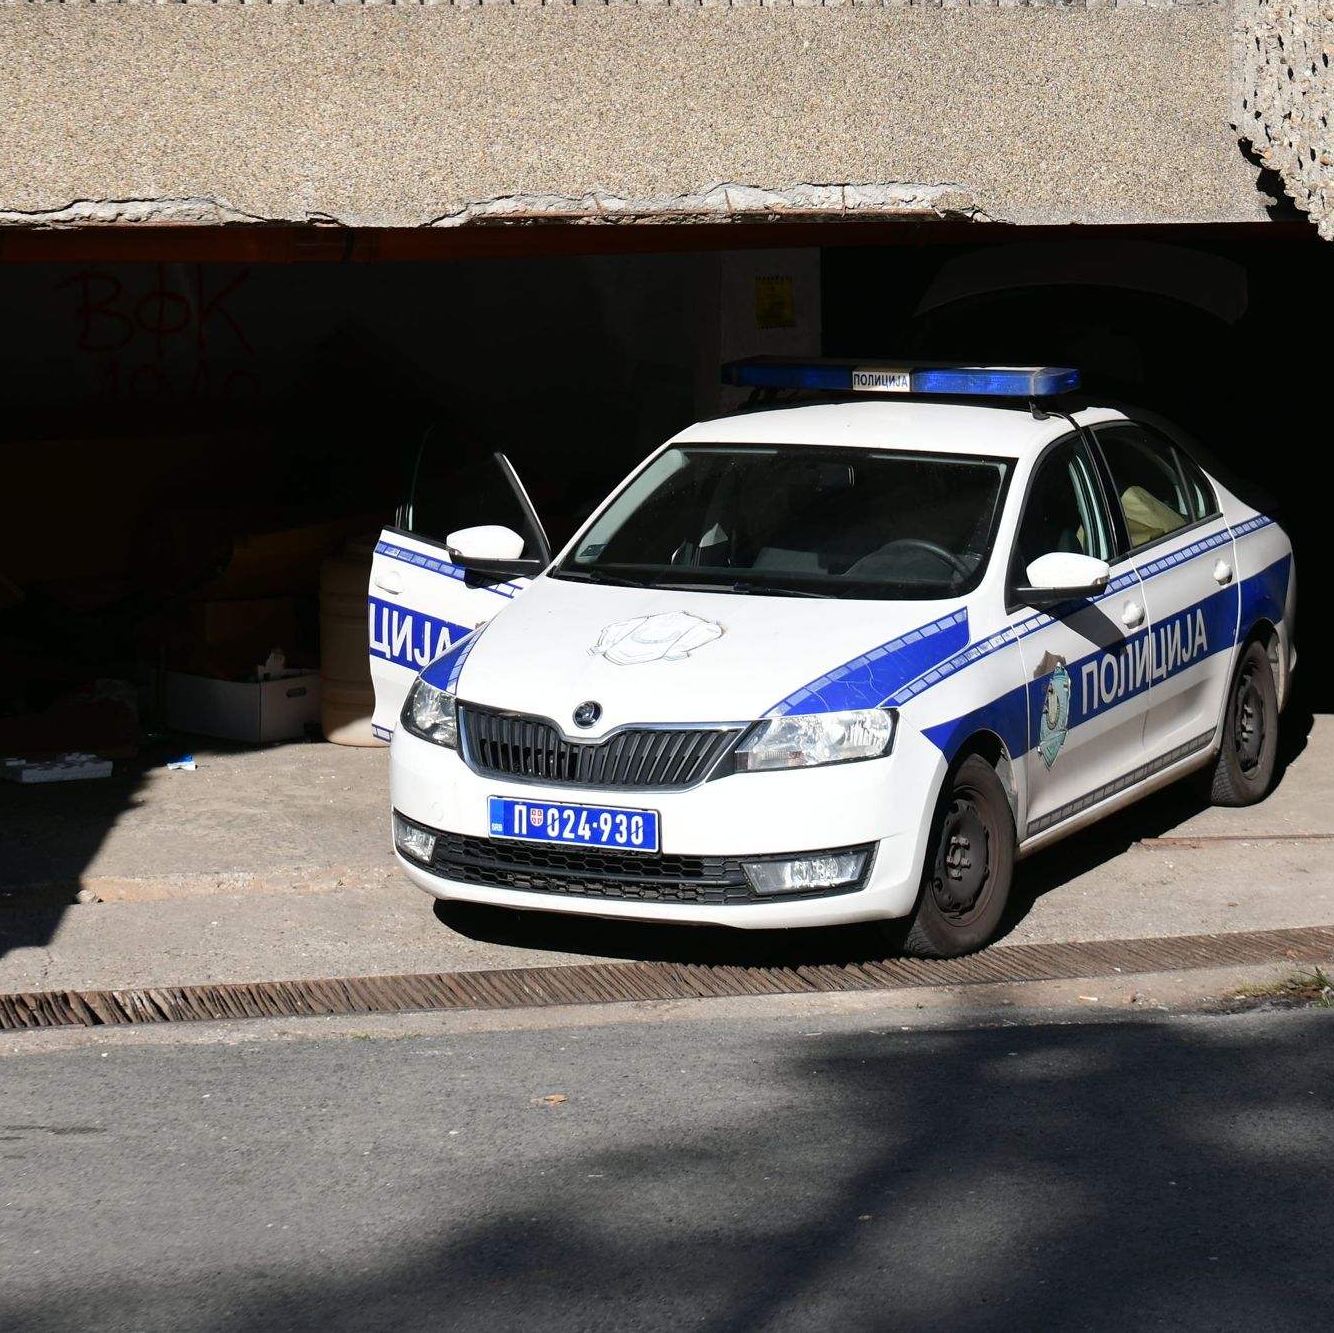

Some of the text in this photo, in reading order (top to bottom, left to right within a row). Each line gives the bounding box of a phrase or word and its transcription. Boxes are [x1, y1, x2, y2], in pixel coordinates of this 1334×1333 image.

[853, 373, 908, 388] ПОЛИЦИЈА
[369, 602, 453, 667] ЦИЈА
[1081, 608, 1208, 715] ПОЛИЦИЈА
[514, 804, 527, 835] П
